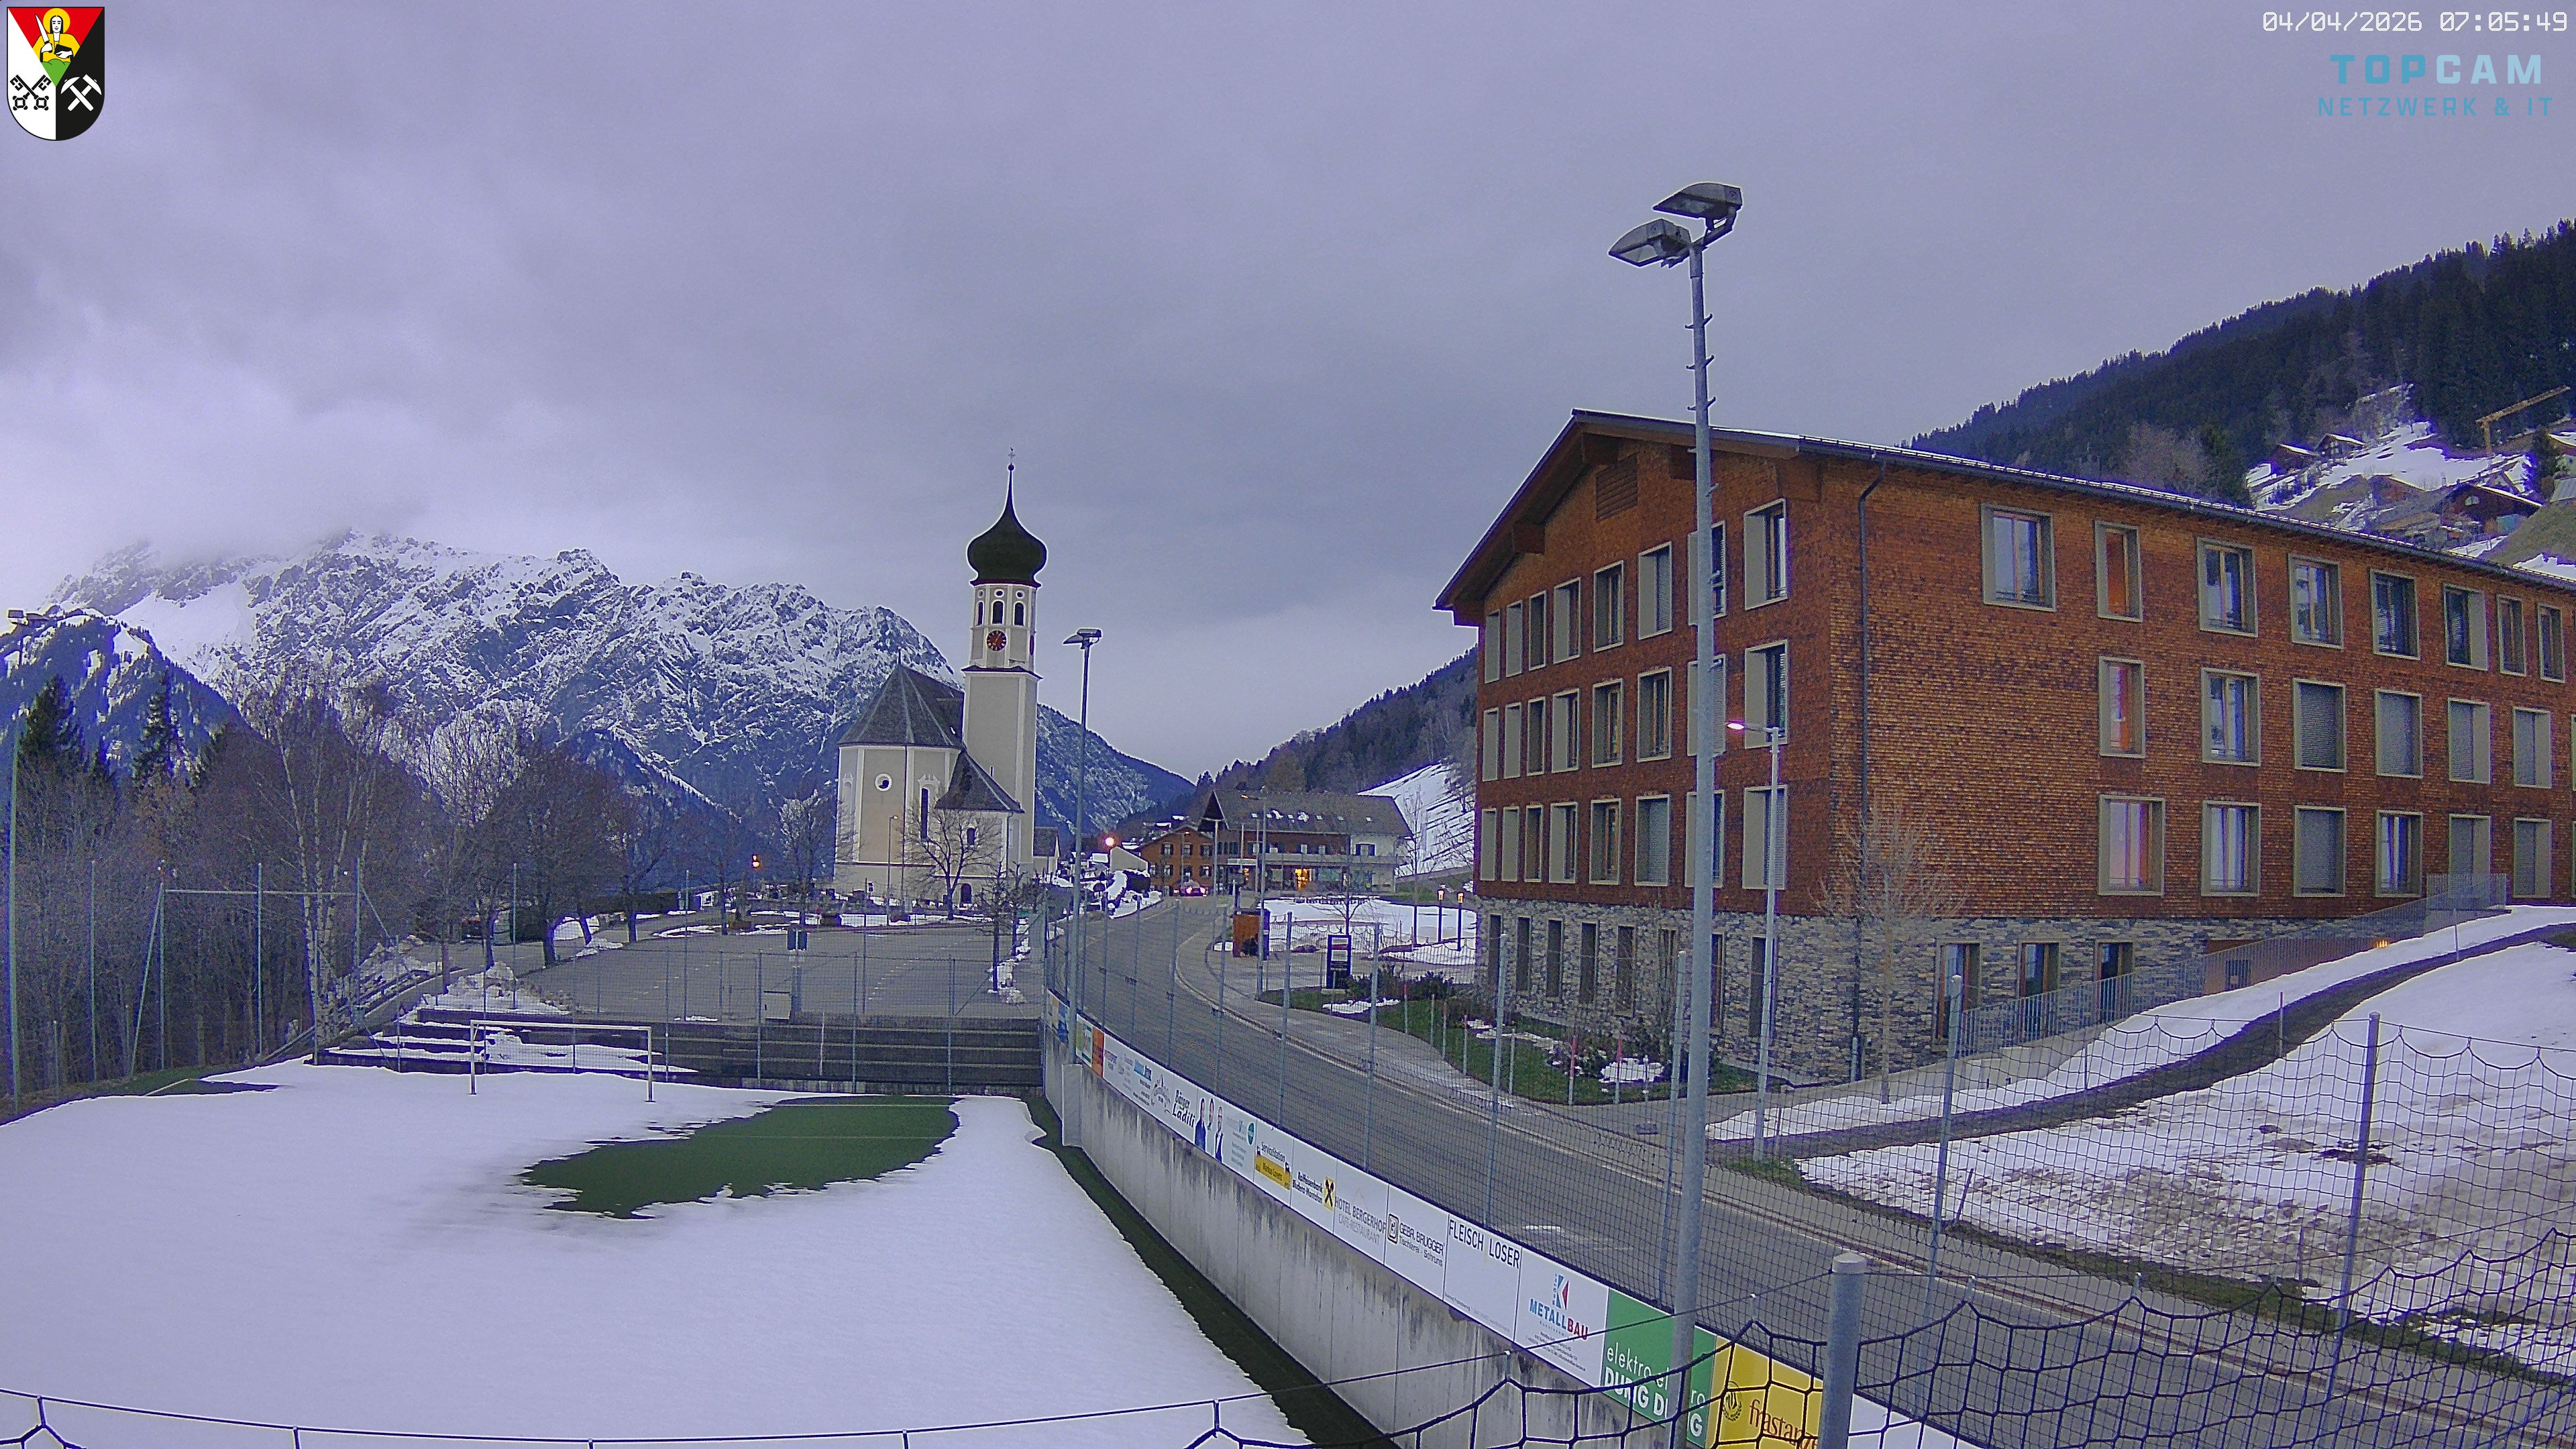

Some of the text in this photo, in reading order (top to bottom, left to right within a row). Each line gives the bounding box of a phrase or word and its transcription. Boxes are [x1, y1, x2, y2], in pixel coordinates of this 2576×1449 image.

[1335, 1195, 1352, 1216] HOTEL
[1416, 1231, 1444, 1256] BRUGGER
[1448, 1219, 1520, 1269] FLEISCH LOSER
[1529, 1298, 1589, 1340] METALLBAU
[1607, 1342, 1652, 1378] elektro
